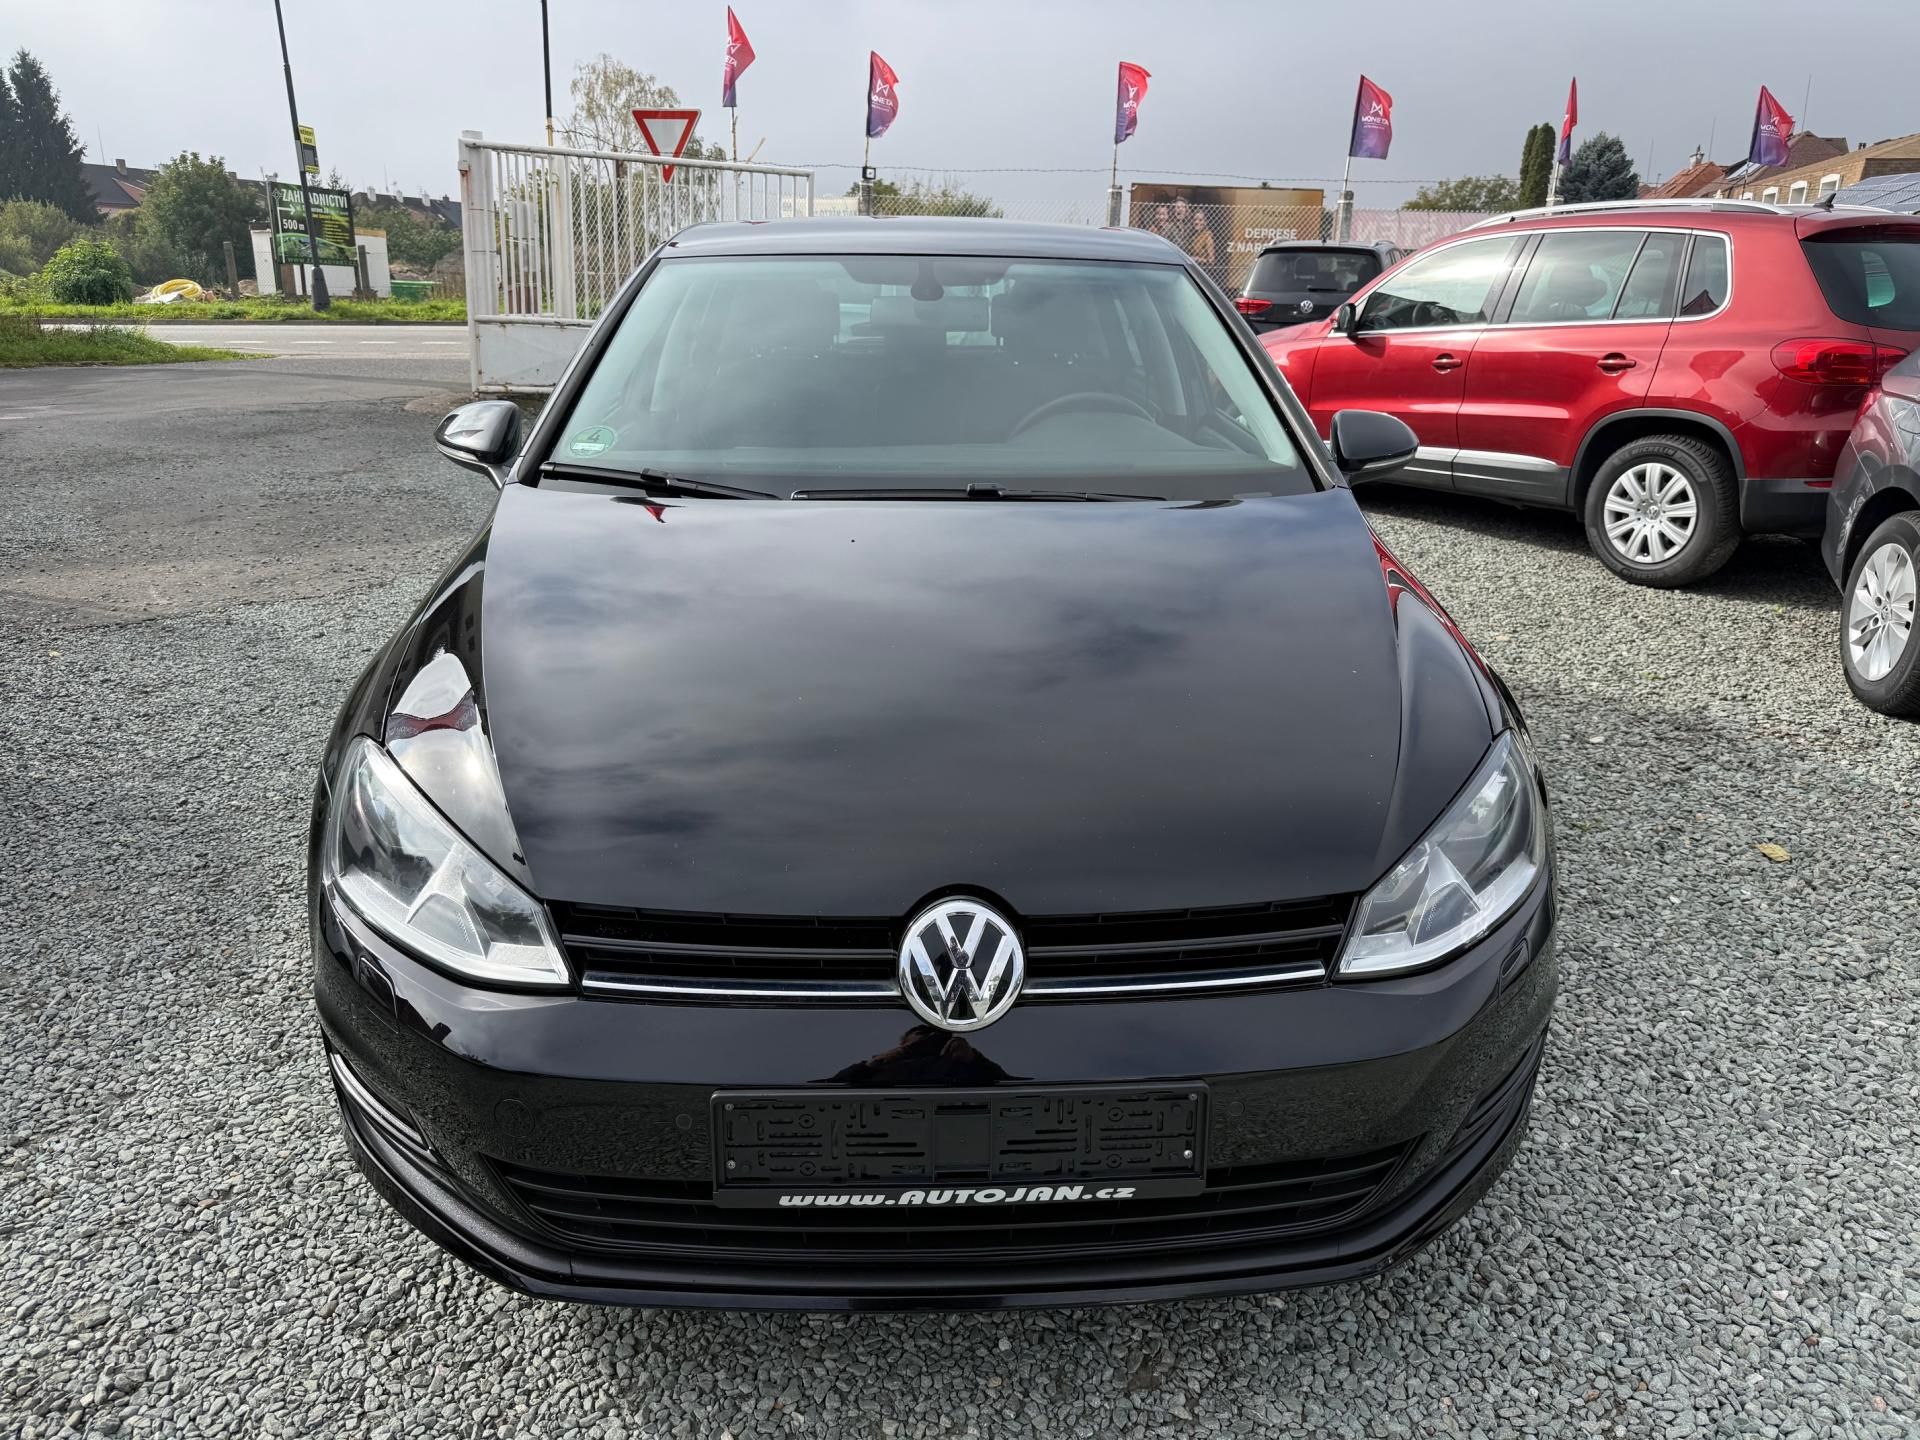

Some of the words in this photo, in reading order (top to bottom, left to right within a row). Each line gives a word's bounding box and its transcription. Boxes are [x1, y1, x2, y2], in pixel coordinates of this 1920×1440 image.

[281, 189, 348, 208] ZAHDNICTVÍ
[283, 219, 298, 230] 500
[299, 223, 305, 231] m
[1245, 228, 1297, 240] DEPRESE
[1227, 242, 1234, 252] Z
[586, 430, 601, 442] 4
[778, 1185, 1137, 1206] www.AUTOJAN.cz
